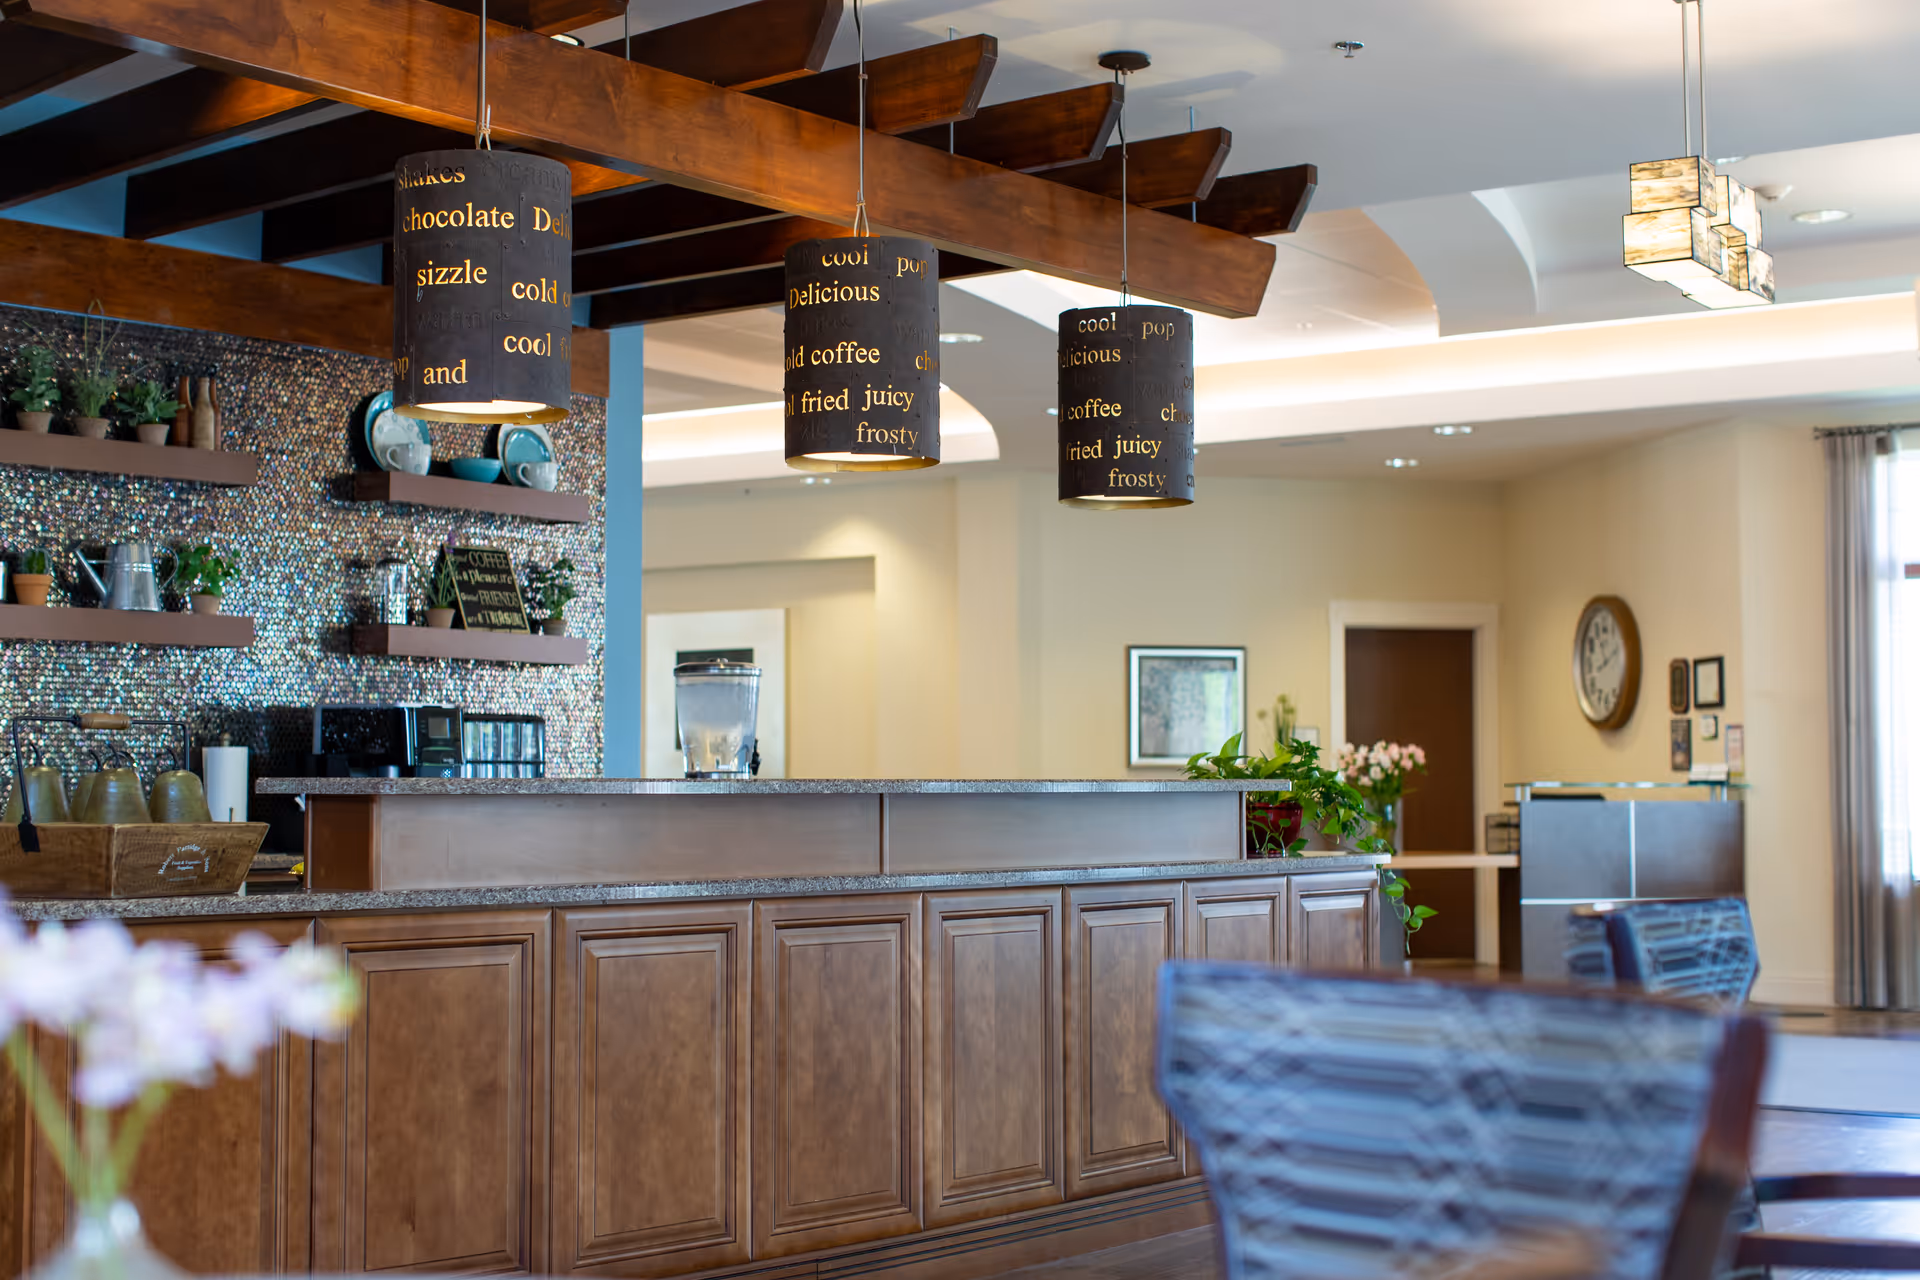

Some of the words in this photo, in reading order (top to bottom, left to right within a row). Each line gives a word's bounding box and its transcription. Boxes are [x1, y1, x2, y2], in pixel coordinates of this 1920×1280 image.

[398, 160, 466, 191] shakes
[402, 201, 515, 233] chocolate
[821, 243, 869, 268] cool
[895, 255, 930, 281] pop
[416, 258, 488, 287] sizzle
[511, 277, 558, 305] cold
[789, 279, 881, 311] Delicious
[1078, 311, 1117, 334] cool
[1141, 320, 1176, 342] pop
[502, 332, 551, 358] cool
[810, 340, 881, 365] coffee
[423, 358, 468, 385] and
[800, 388, 850, 415] fried
[861, 383, 915, 413] juicy
[1067, 397, 1122, 421] coffee
[856, 421, 919, 450] frosty
[1066, 439, 1103, 462] fried
[1113, 434, 1162, 460] juicy
[1108, 467, 1167, 493] frosty
[469, 551, 508, 568] COFFEE
[478, 590, 520, 608] FRIENDS
